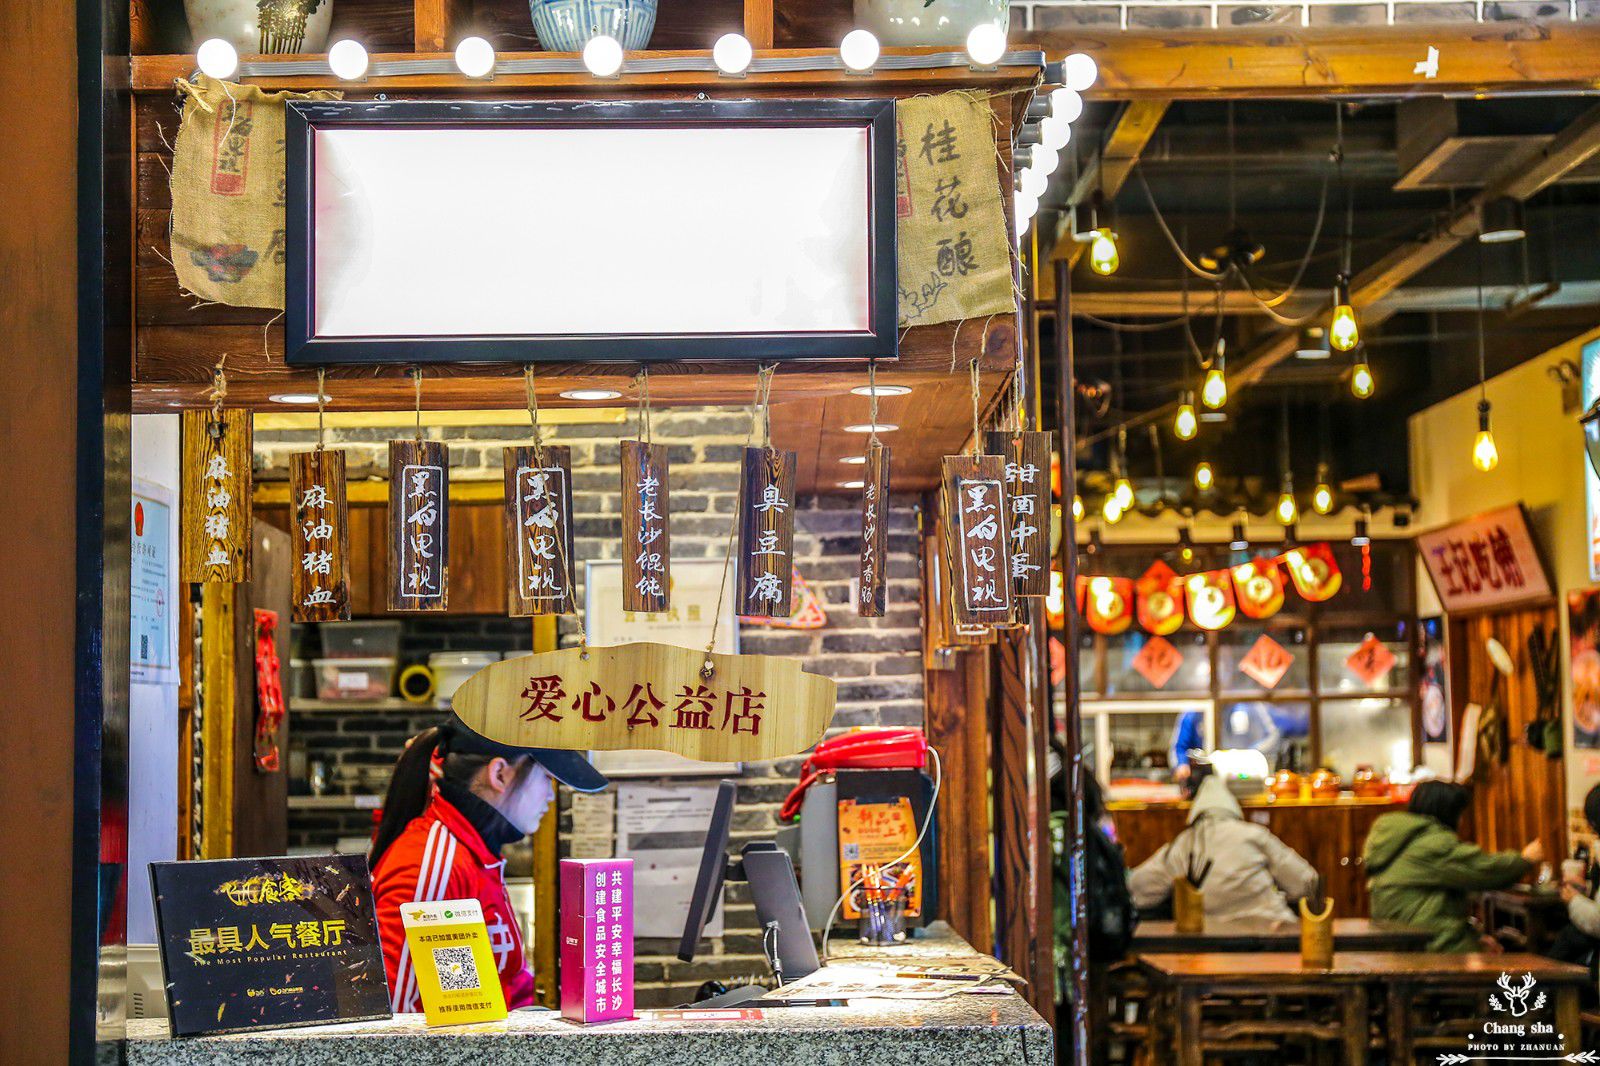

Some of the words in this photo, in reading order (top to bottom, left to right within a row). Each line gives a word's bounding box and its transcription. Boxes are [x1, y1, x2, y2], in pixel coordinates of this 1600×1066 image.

[919, 118, 979, 277] 桂花酿
[204, 454, 234, 566] 麻油猪血
[297, 484, 337, 607] 麻油猪血
[408, 471, 437, 590] 黑白电视
[635, 475, 665, 598] 老长沙馄饨
[749, 483, 789, 603] 臭豆腐
[861, 482, 877, 604] 老长沙大香肠
[965, 485, 1003, 603] 黑白电视
[519, 675, 767, 736] 爱心公益店
[188, 918, 346, 955] 最具人气餐厅
[217, 957, 242, 966] Most
[247, 953, 287, 963] Popular
[292, 949, 348, 960] Restaurant
[595, 871, 606, 1014] 创建食品安全城市
[611, 870, 622, 1011] 共建平安幸福长沙
